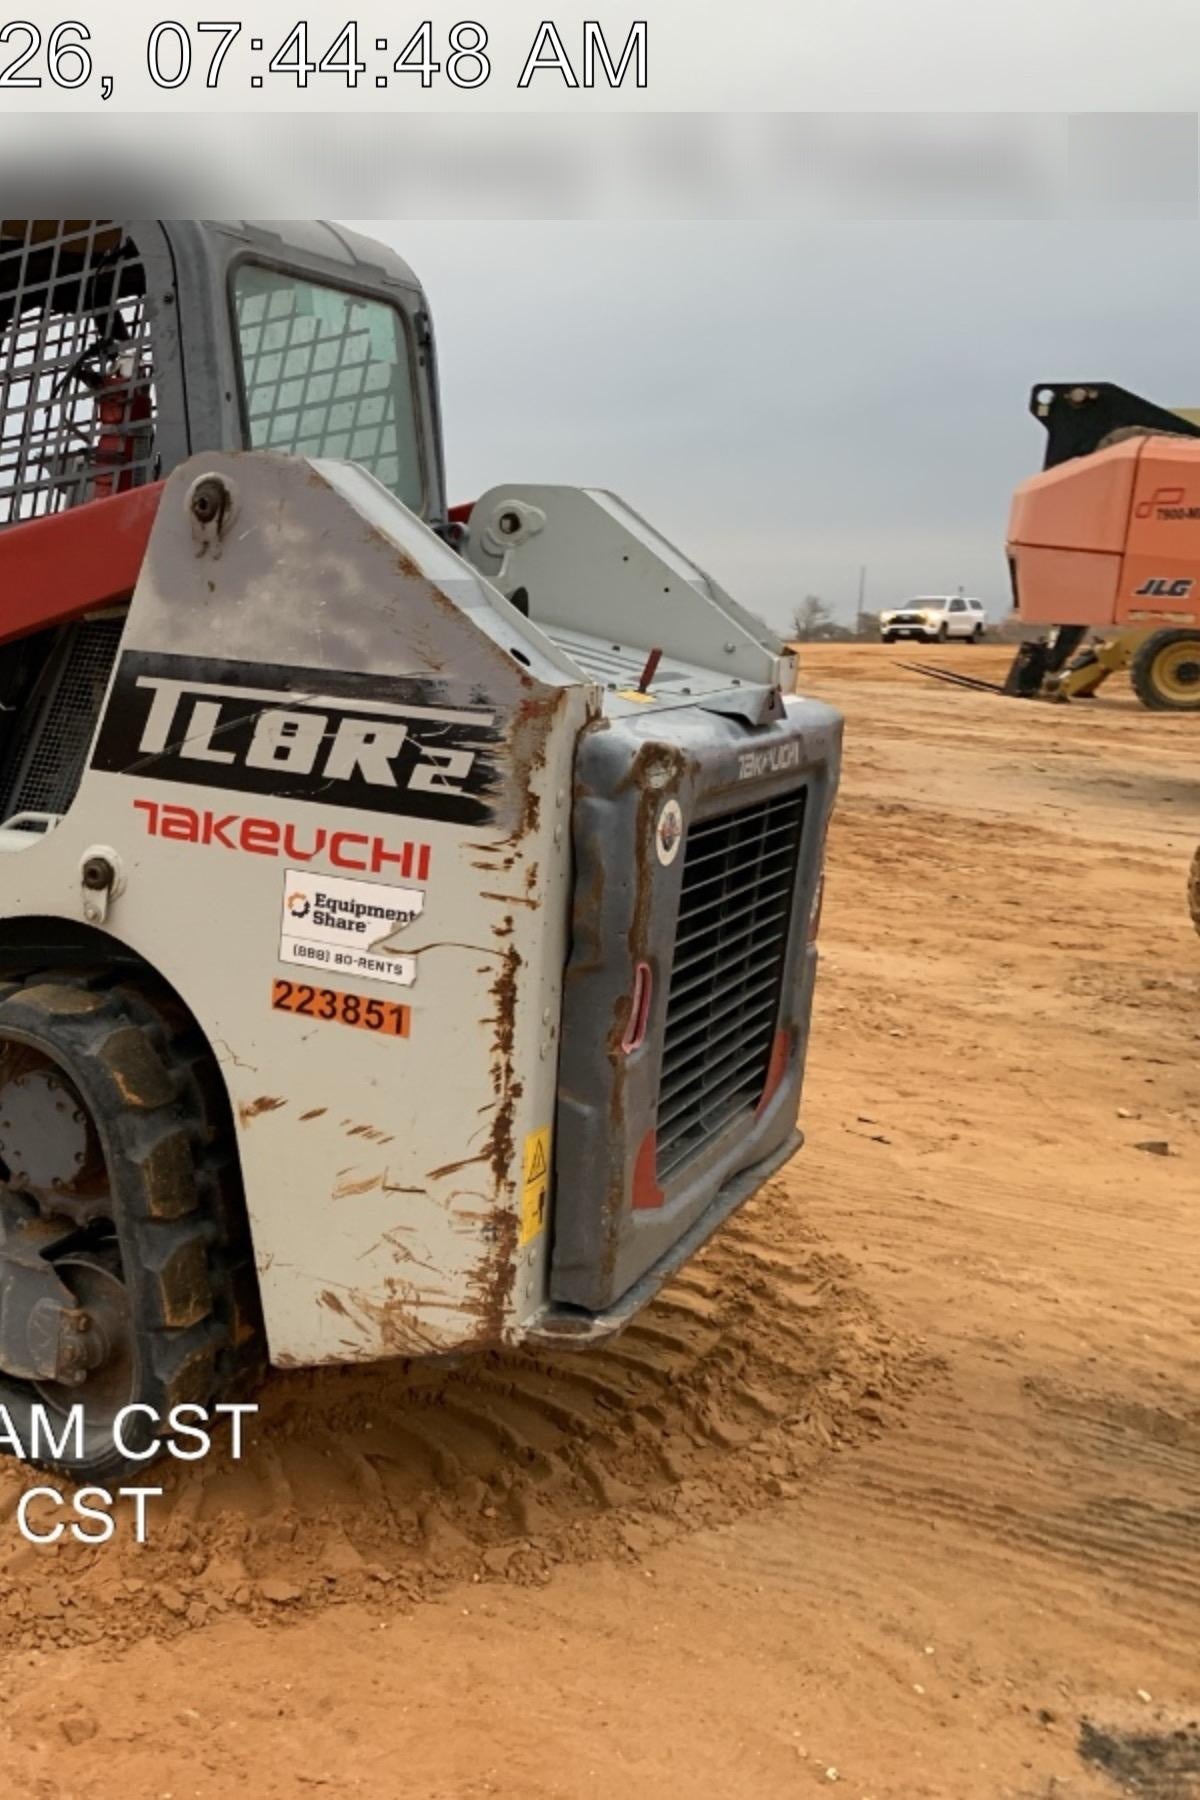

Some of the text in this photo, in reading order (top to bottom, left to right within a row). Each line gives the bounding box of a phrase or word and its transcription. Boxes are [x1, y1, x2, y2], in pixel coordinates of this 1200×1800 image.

[1135, 578, 1194, 597] JLG
[314, 892, 417, 923] Equipment
[313, 911, 367, 933] Share
[273, 980, 405, 1034] 223851
